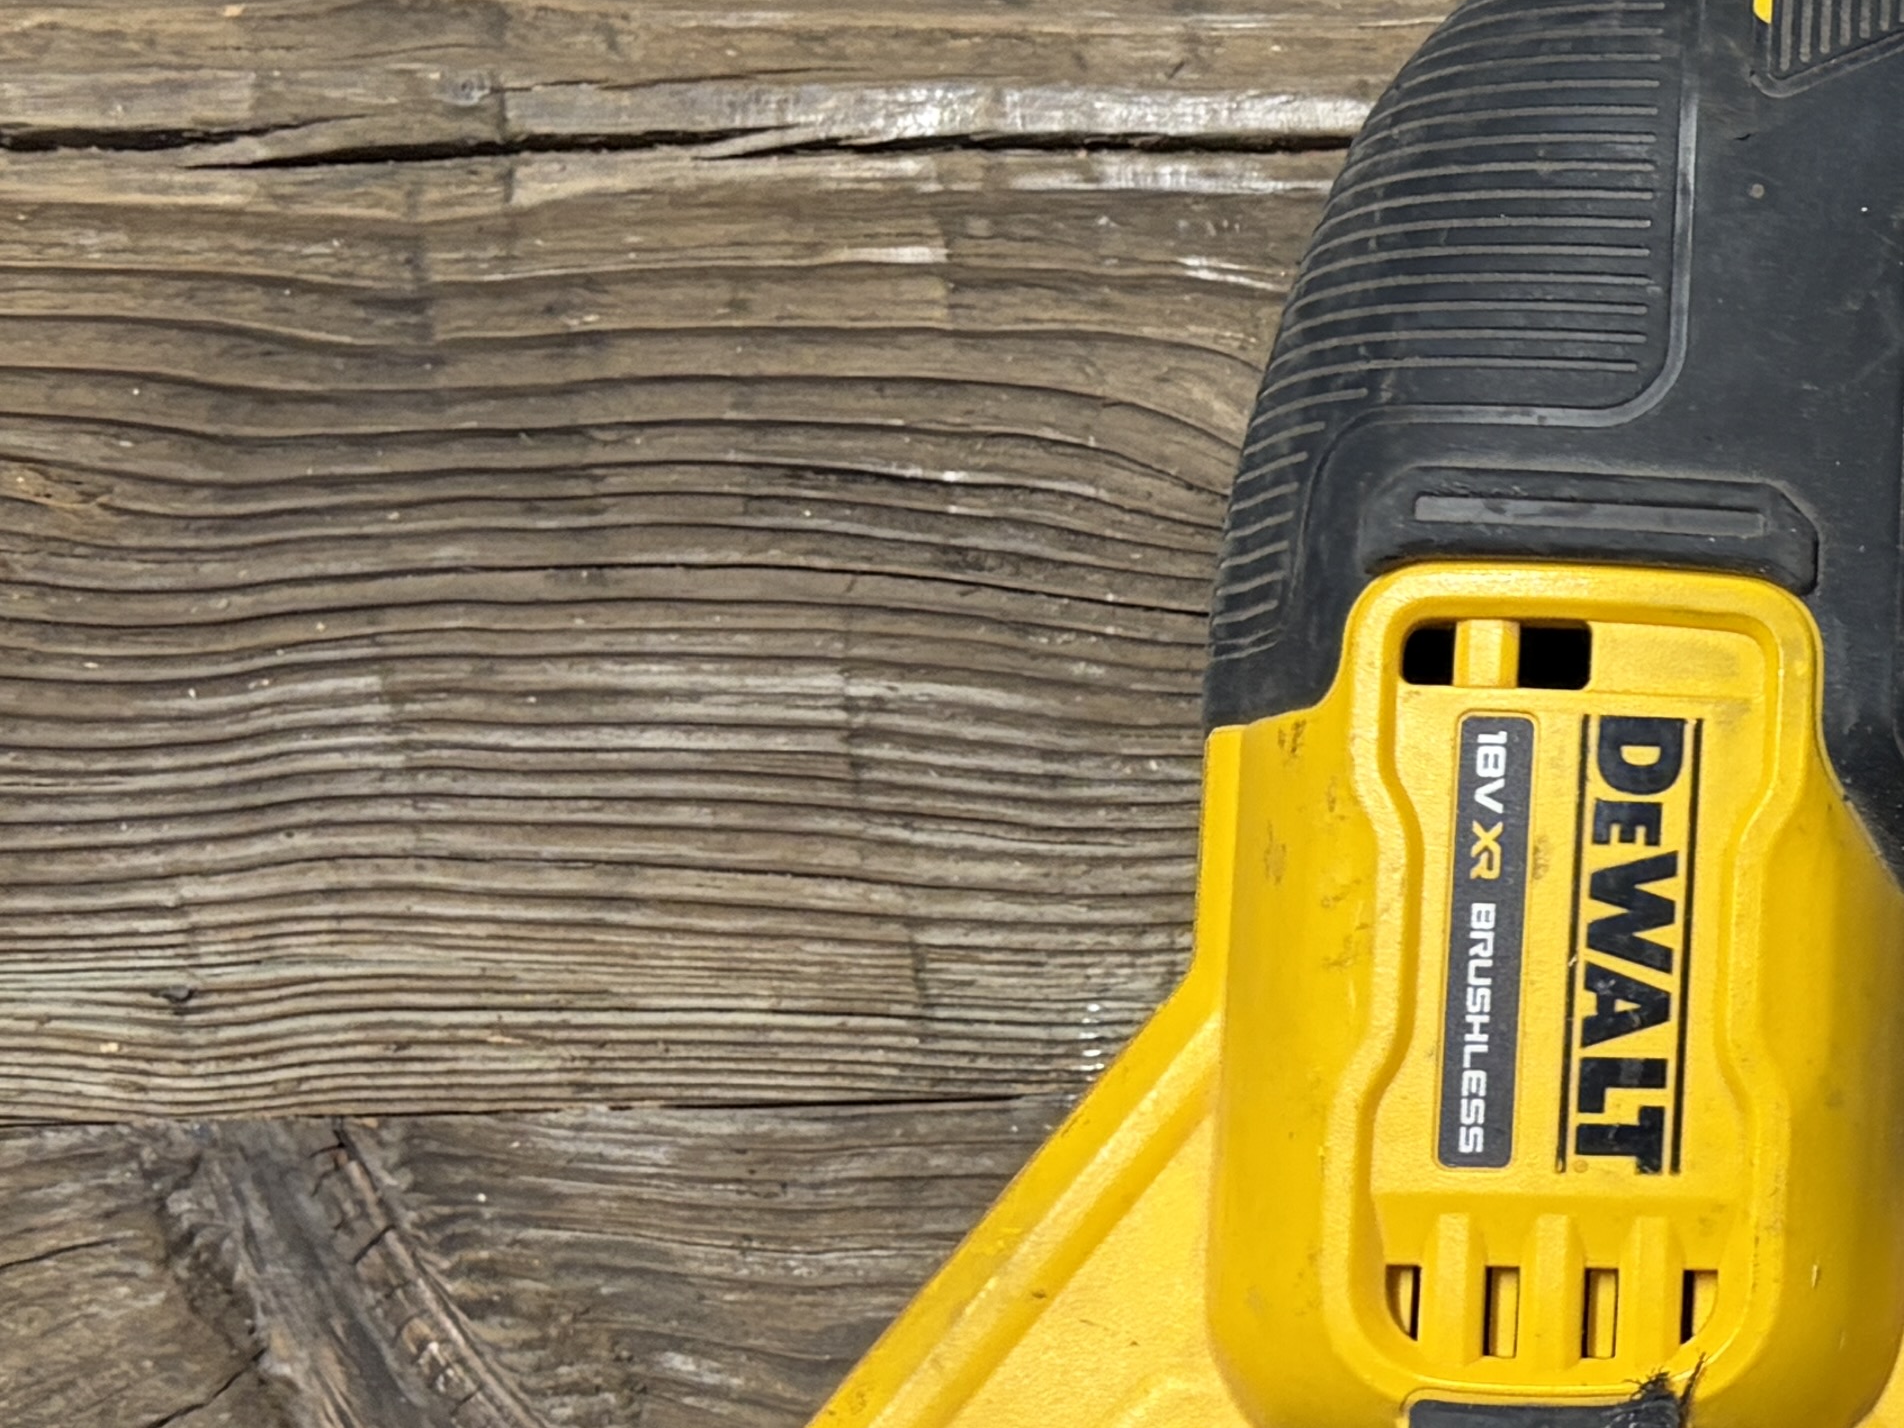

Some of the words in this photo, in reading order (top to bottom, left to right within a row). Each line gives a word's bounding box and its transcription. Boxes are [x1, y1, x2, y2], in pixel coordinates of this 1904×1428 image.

[1469, 821, 1504, 881] XR
[1474, 730, 1507, 814] 18V
[1458, 902, 1497, 1154] BRUSHLESS
[1573, 715, 1688, 1174] DEWALT
